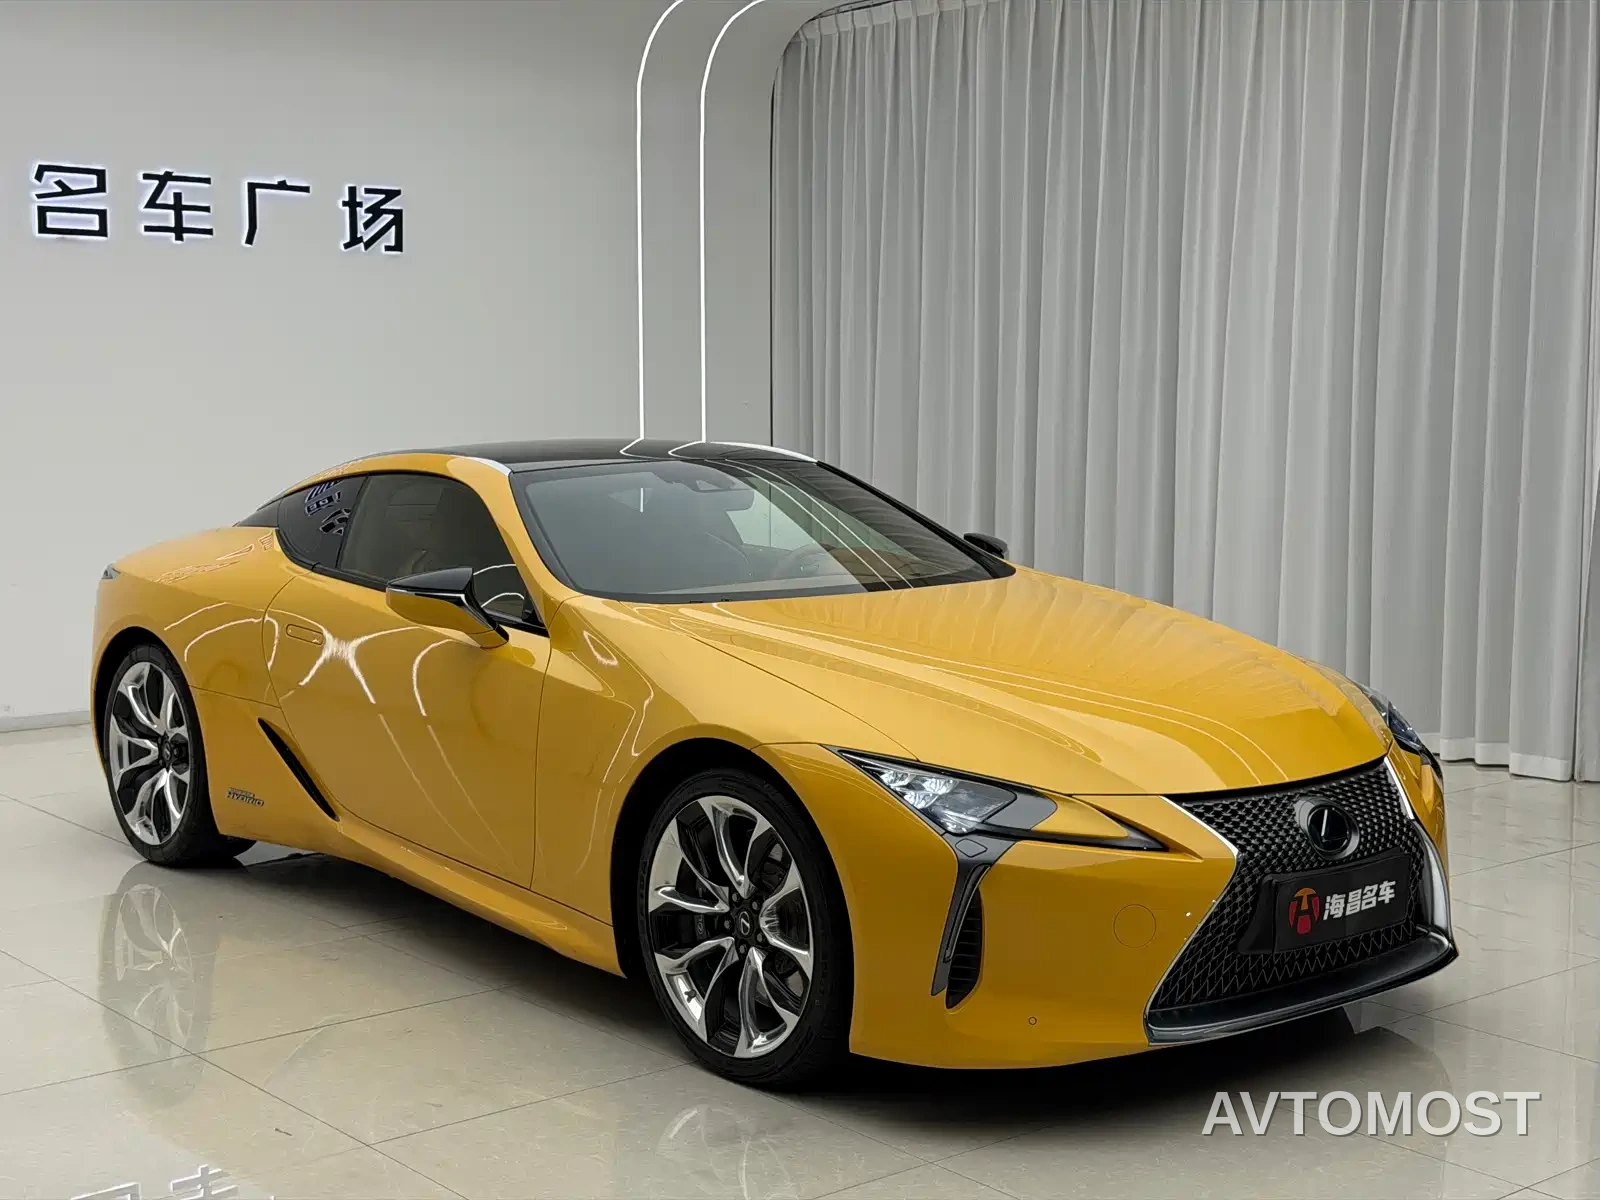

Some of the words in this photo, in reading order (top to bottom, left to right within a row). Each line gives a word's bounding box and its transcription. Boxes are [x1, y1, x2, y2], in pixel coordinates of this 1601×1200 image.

[34, 163, 404, 253] 名车广场
[1323, 880, 1396, 920] 海昌名车
